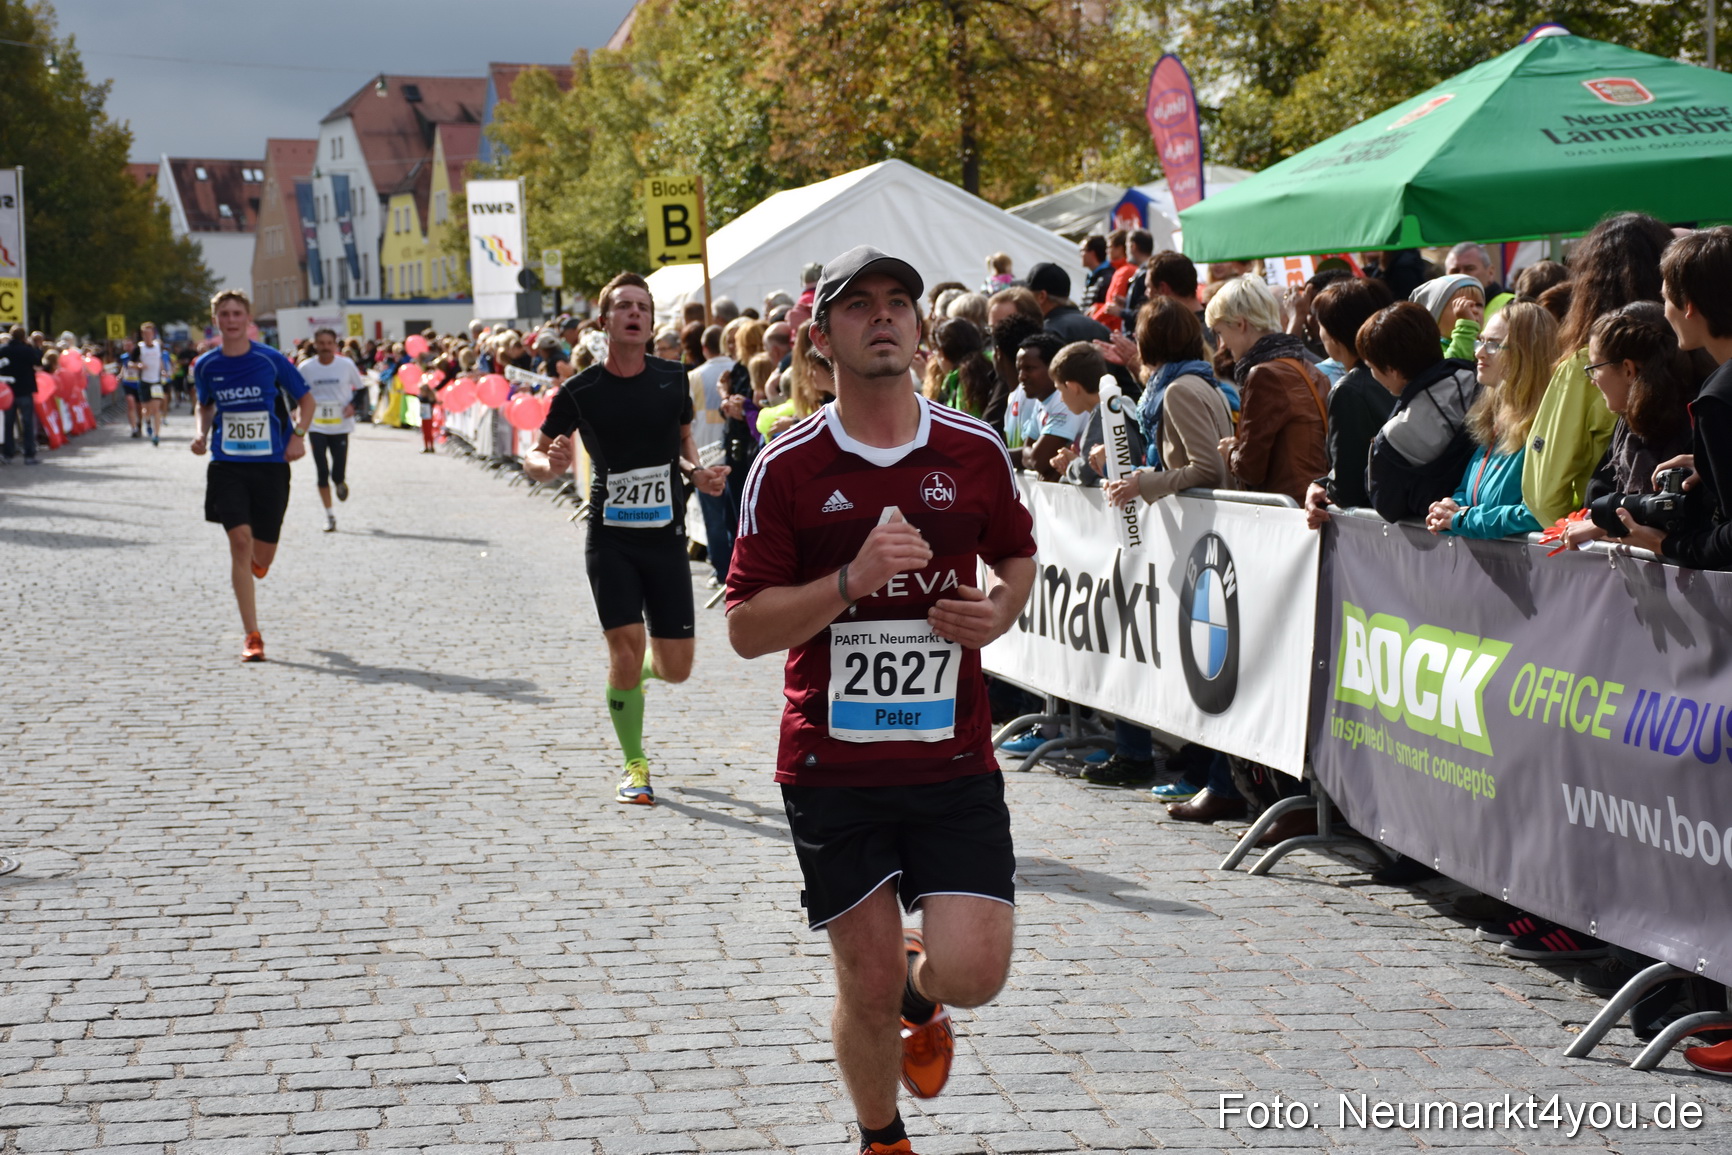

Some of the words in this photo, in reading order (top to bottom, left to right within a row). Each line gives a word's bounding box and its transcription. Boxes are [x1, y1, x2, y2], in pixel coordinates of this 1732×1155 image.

[1561, 105, 1729, 127] Neumarkter
[1540, 116, 1732, 144] Lammsbr
[652, 180, 698, 197] Block
[662, 204, 692, 247] B
[0, 291, 14, 312] C
[228, 422, 265, 439] 2057
[1112, 424, 1131, 466] BMW
[608, 477, 631, 487] PARTL
[632, 472, 662, 482] Neumarkt
[612, 481, 666, 505] 2476
[924, 487, 953, 501] FCN
[617, 510, 660, 521] Christoph
[822, 502, 854, 513] adidas
[871, 568, 959, 598] EVA
[834, 633, 877, 646] PARTL
[880, 632, 940, 645] Neumarkt
[844, 650, 951, 697] 2627
[1341, 615, 1498, 737] BOCK
[1508, 662, 1625, 740] OFFICE
[875, 708, 922, 726] Peter
[1330, 708, 1384, 752] inspired
[1395, 740, 1430, 776] smart
[1432, 755, 1496, 801] concepts
